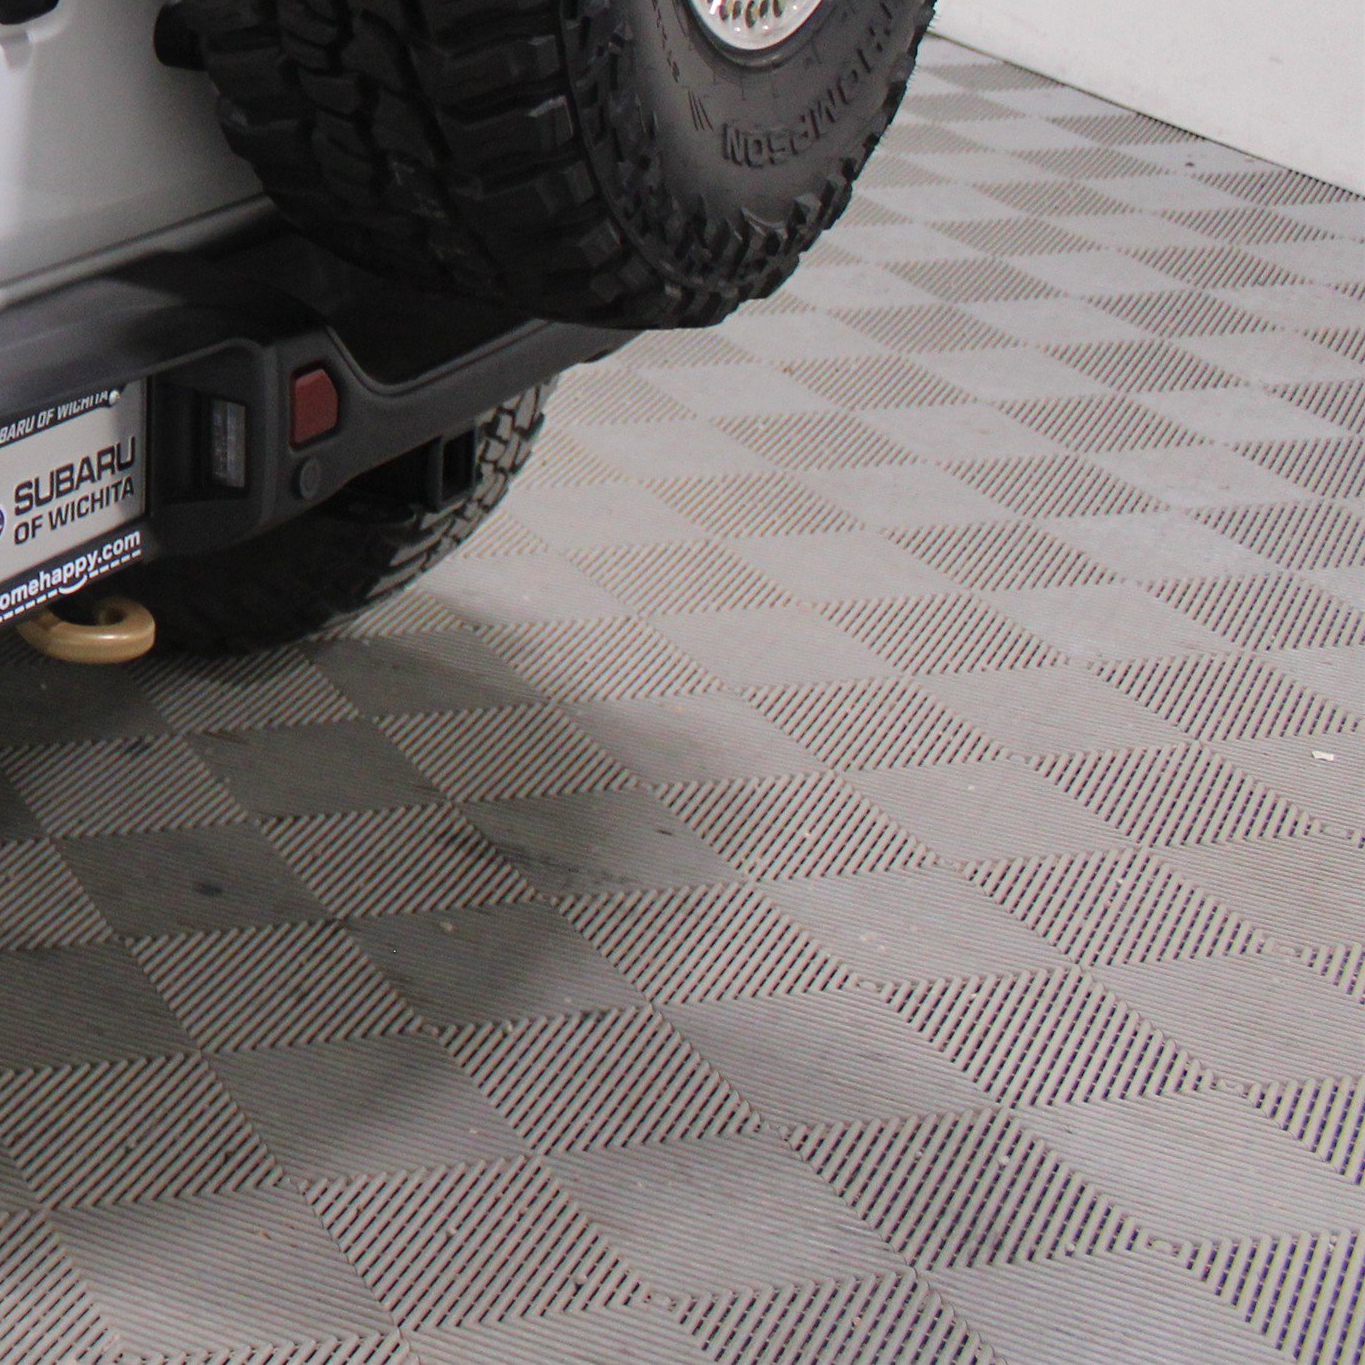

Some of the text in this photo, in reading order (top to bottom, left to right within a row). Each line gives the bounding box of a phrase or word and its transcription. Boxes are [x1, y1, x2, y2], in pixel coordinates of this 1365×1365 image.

[36, 408, 56, 429] OF
[14, 435, 136, 517] SUBARU
[14, 475, 135, 545] OF WICHITA
